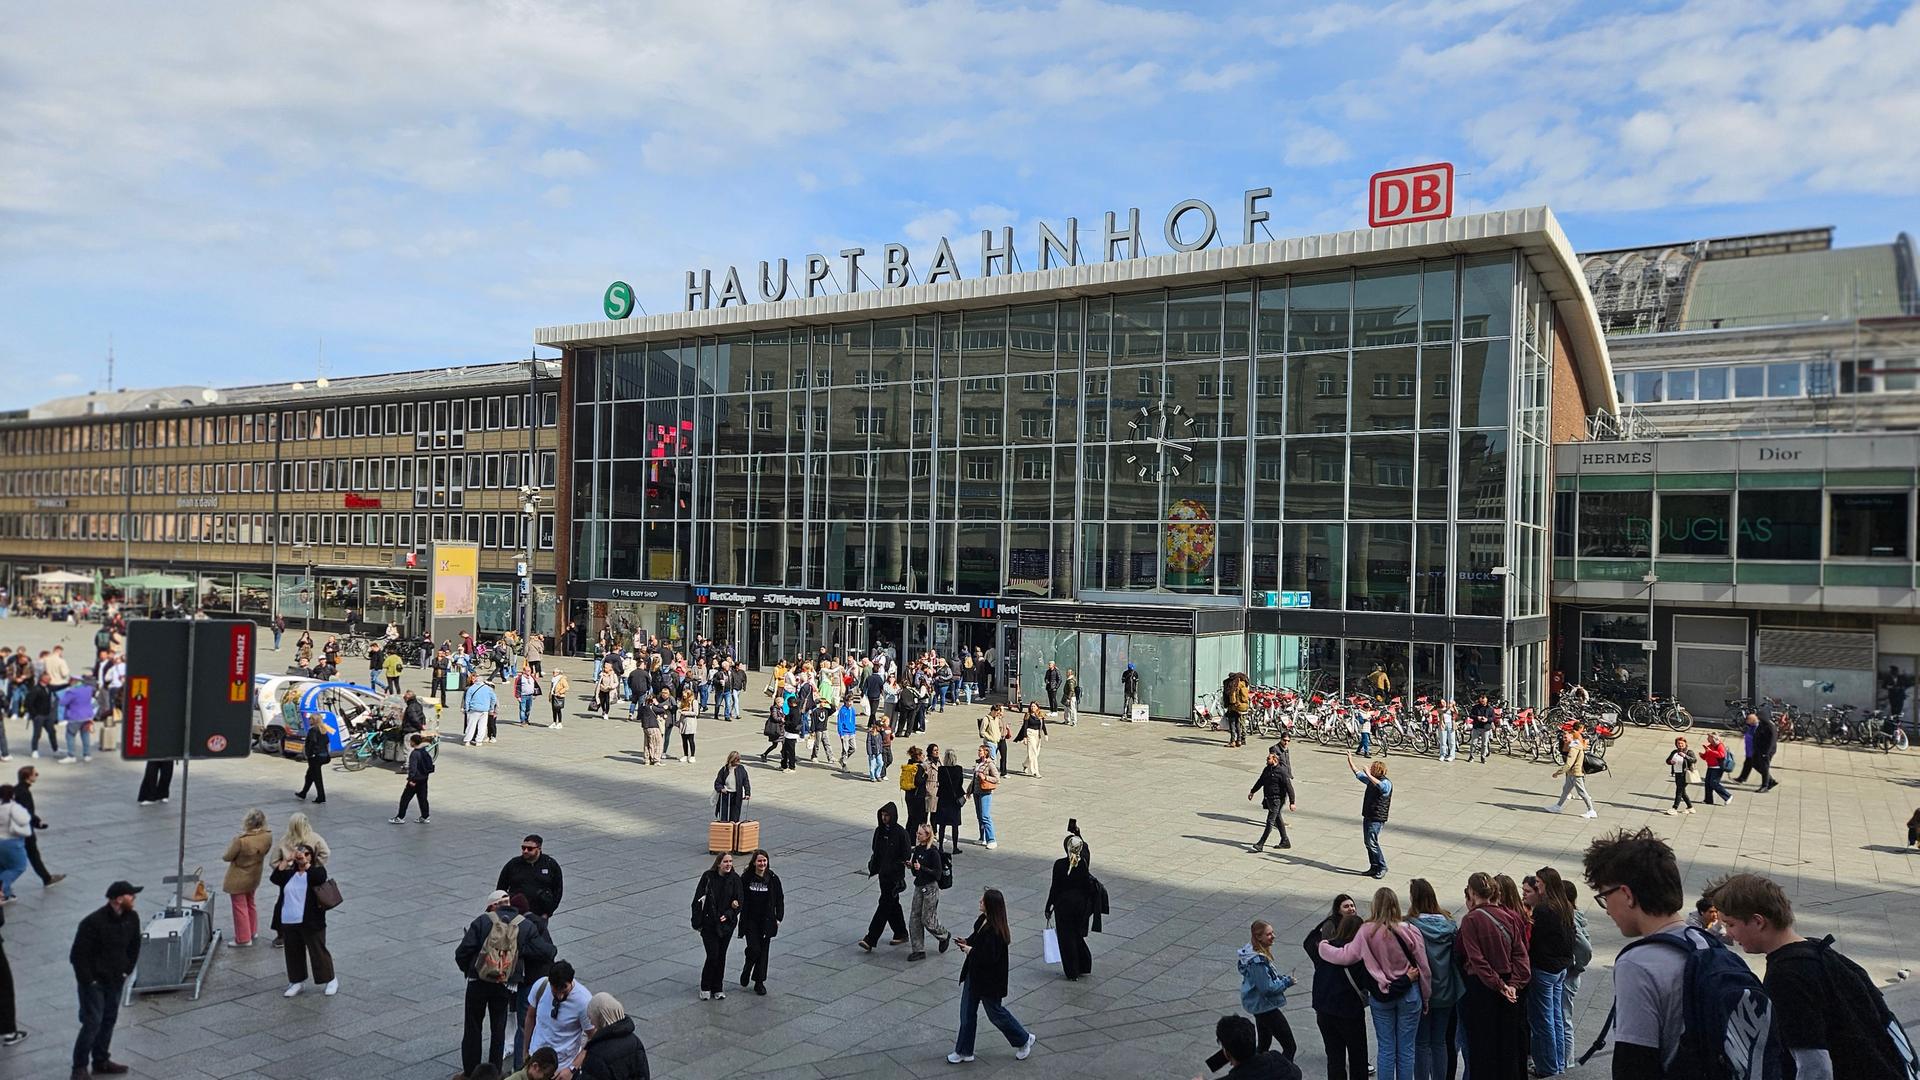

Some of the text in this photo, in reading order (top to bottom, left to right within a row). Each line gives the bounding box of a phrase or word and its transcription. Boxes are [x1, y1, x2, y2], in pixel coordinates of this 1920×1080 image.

[1379, 174, 1441, 218] DB
[685, 187, 1272, 312] HAUPTBAHNHOF
[1582, 451, 1652, 465] HERMÈS
[1759, 447, 1802, 461] Dior
[1626, 516, 1773, 542] DOUGLAS
[644, 590, 658, 598] SHOP
[710, 591, 757, 604] NetCologne
[776, 594, 821, 606] Highspeed
[842, 597, 896, 611] NetCologne
[919, 600, 971, 613] Highspeed
[236, 634, 246, 675] ZEPPELIN
[133, 705, 143, 748] ZEPPELIN
[1724, 988, 1769, 1080] NIKE
